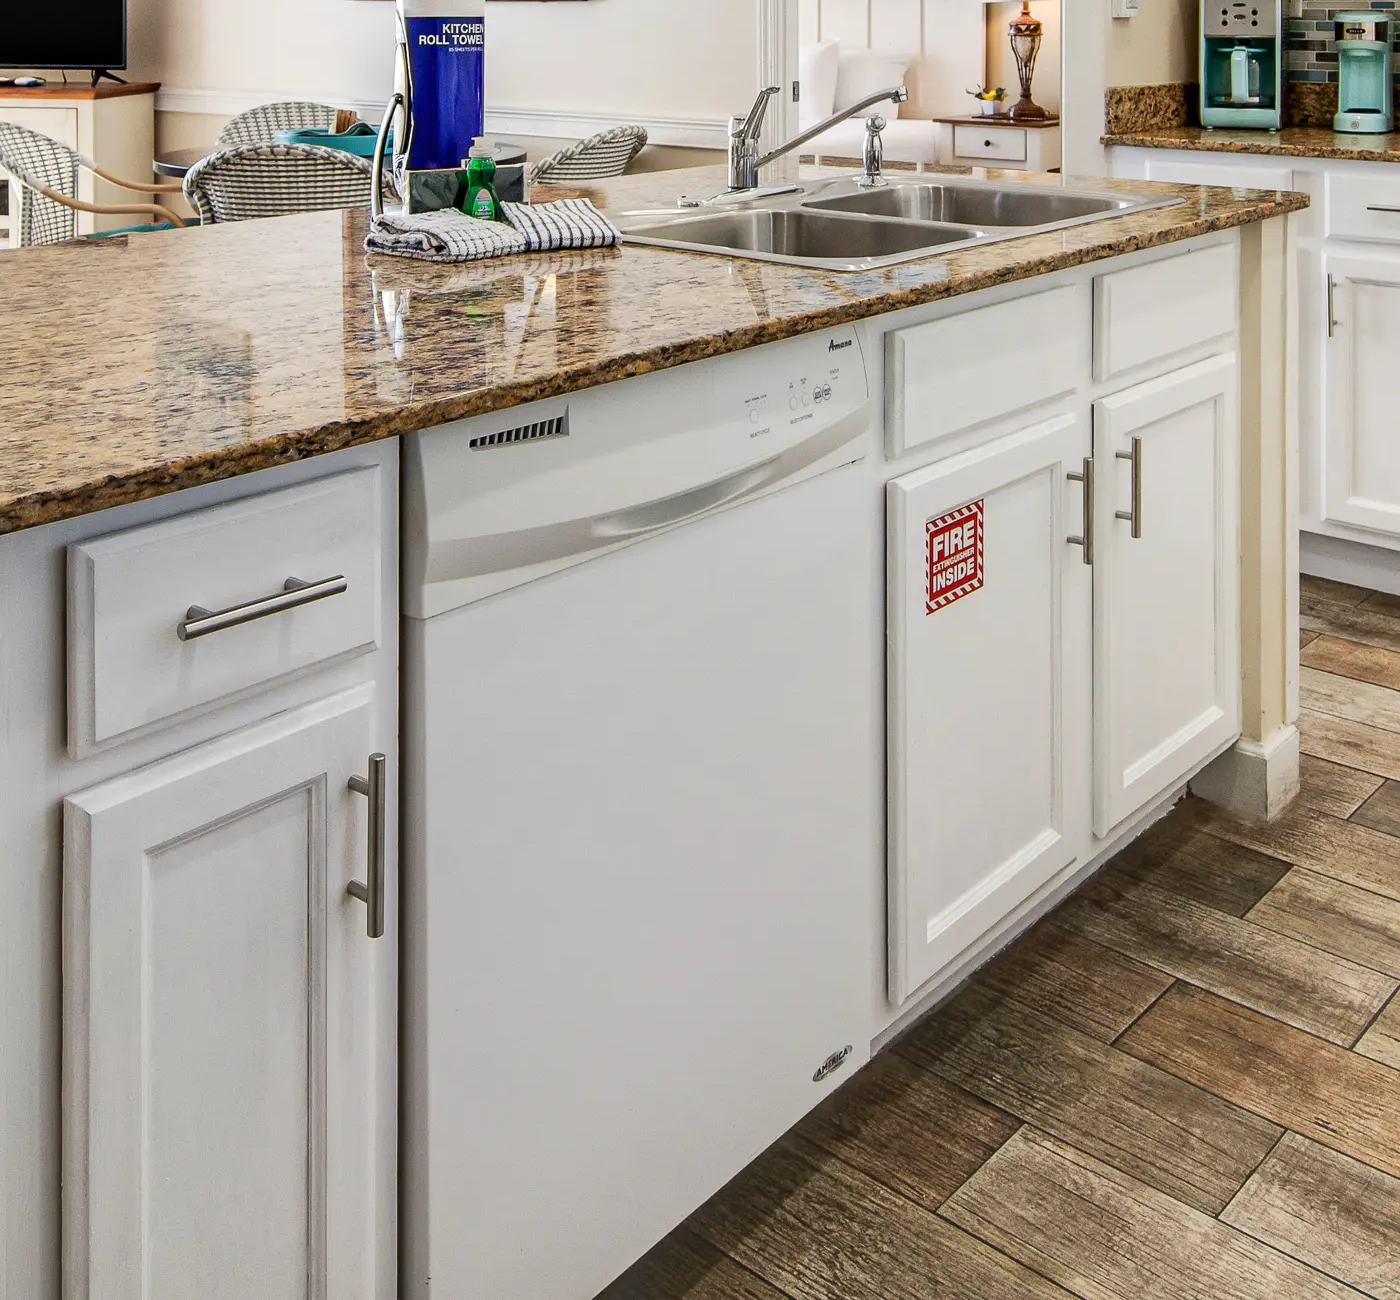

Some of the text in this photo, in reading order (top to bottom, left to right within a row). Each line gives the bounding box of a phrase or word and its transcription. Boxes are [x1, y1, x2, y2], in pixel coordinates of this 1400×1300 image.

[442, 23, 484, 34] KITCHEN
[418, 34, 484, 45] ROLL TOWEL
[828, 339, 852, 353] Amana
[932, 519, 975, 564] FIRE
[932, 547, 975, 574] EXTINGUISHER
[932, 556, 975, 594] INSIDE
